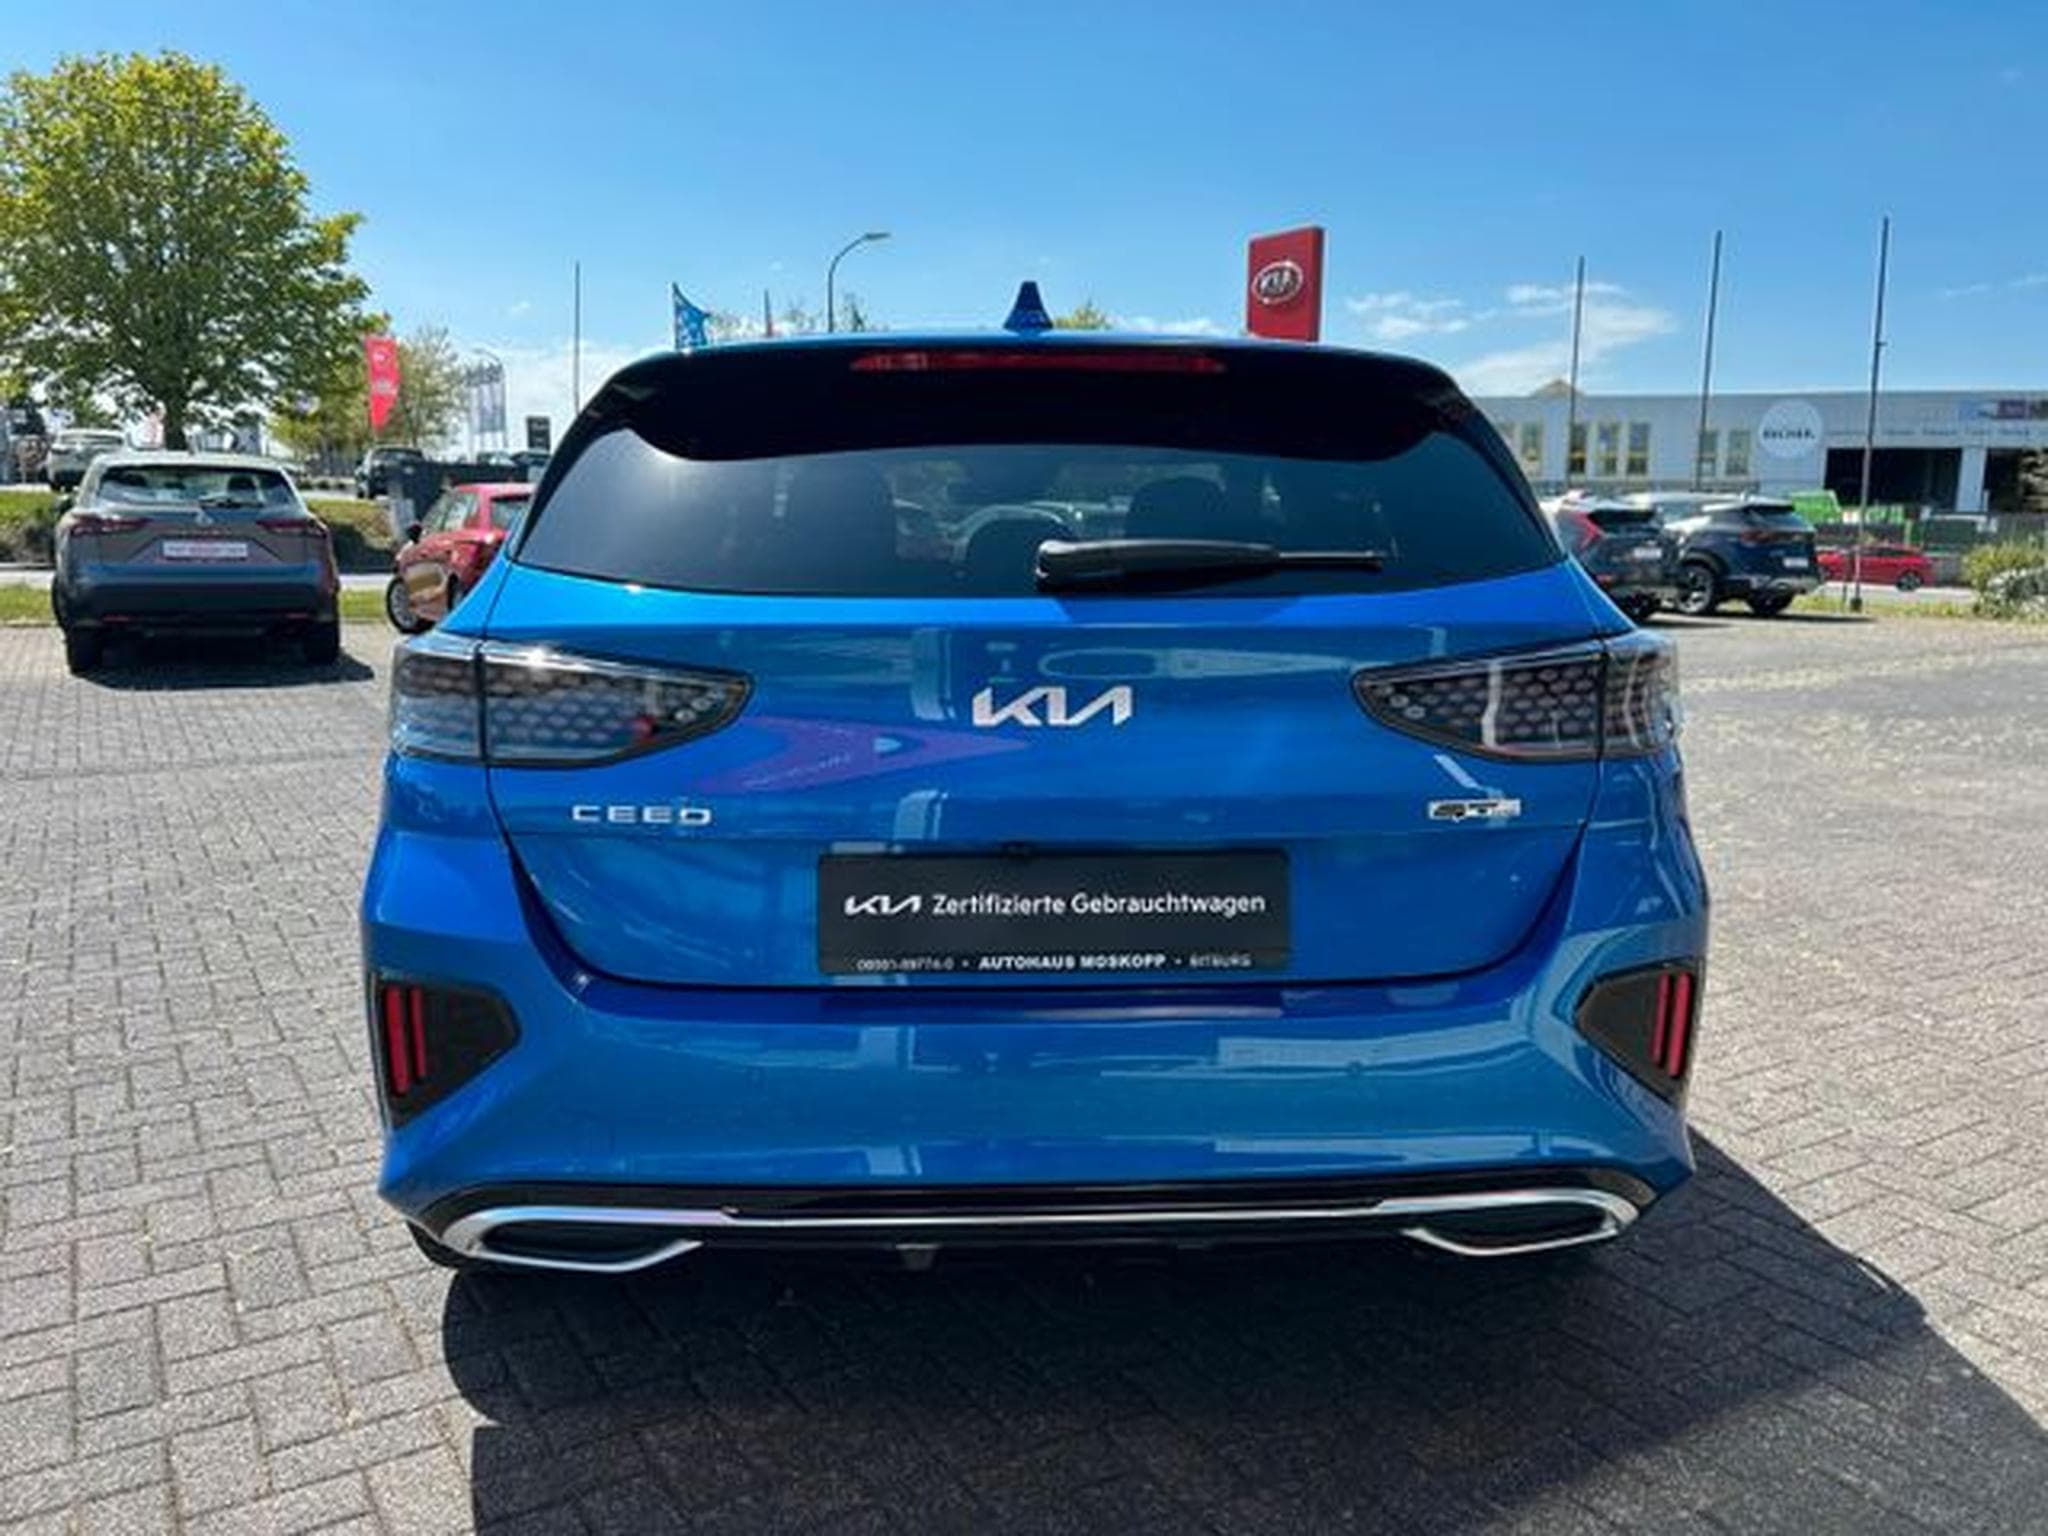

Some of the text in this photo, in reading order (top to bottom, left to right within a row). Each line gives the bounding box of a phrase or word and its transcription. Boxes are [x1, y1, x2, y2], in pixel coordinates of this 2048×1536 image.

[972, 686, 1132, 727] KIA
[572, 804, 712, 826] CEED
[932, 893, 1066, 915] Zertifizierte
[1071, 891, 1266, 918] Gebrauchtwagen
[977, 955, 1076, 971] AUTOHAUS
[1079, 953, 1166, 970] MOSKOPP
